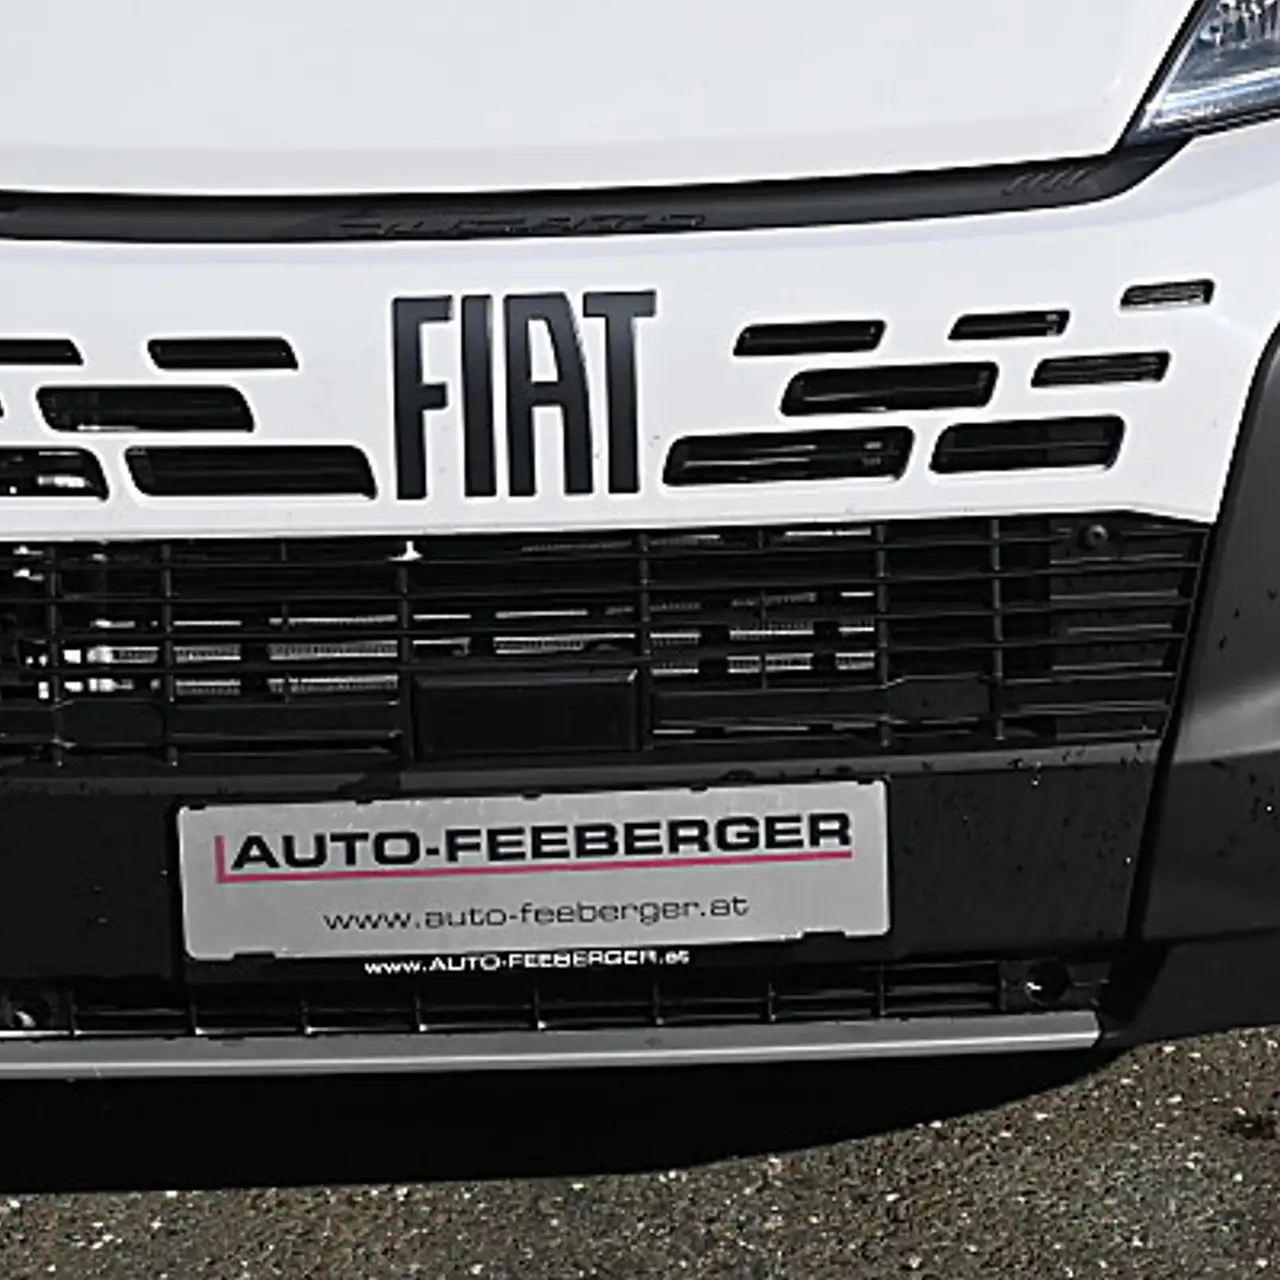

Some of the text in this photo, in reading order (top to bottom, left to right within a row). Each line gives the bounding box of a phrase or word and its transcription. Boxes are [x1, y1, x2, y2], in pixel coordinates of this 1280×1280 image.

[391, 289, 658, 501] FIAT
[231, 811, 853, 869] AUTO-FEEBERGER
[323, 896, 749, 931] www.auto-feeberger.at
